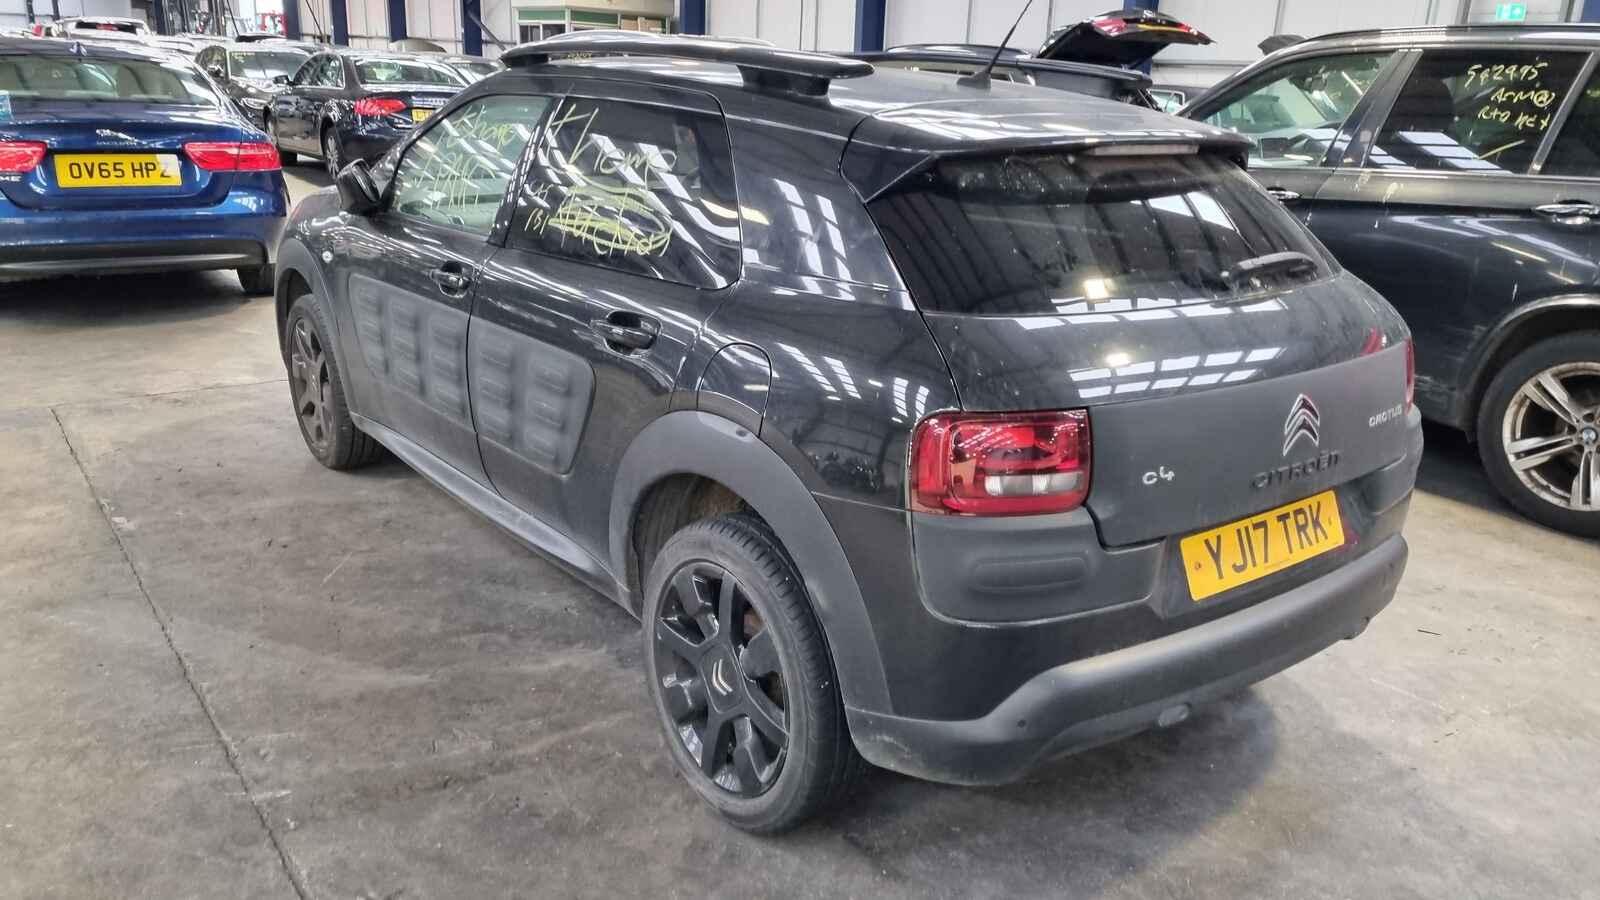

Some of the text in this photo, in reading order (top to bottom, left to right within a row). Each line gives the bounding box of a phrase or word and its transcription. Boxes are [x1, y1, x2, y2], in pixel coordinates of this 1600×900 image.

[69, 161, 125, 179] OV65
[1142, 466, 1175, 485] C4
[1204, 501, 1329, 580] YJ17 TRK
